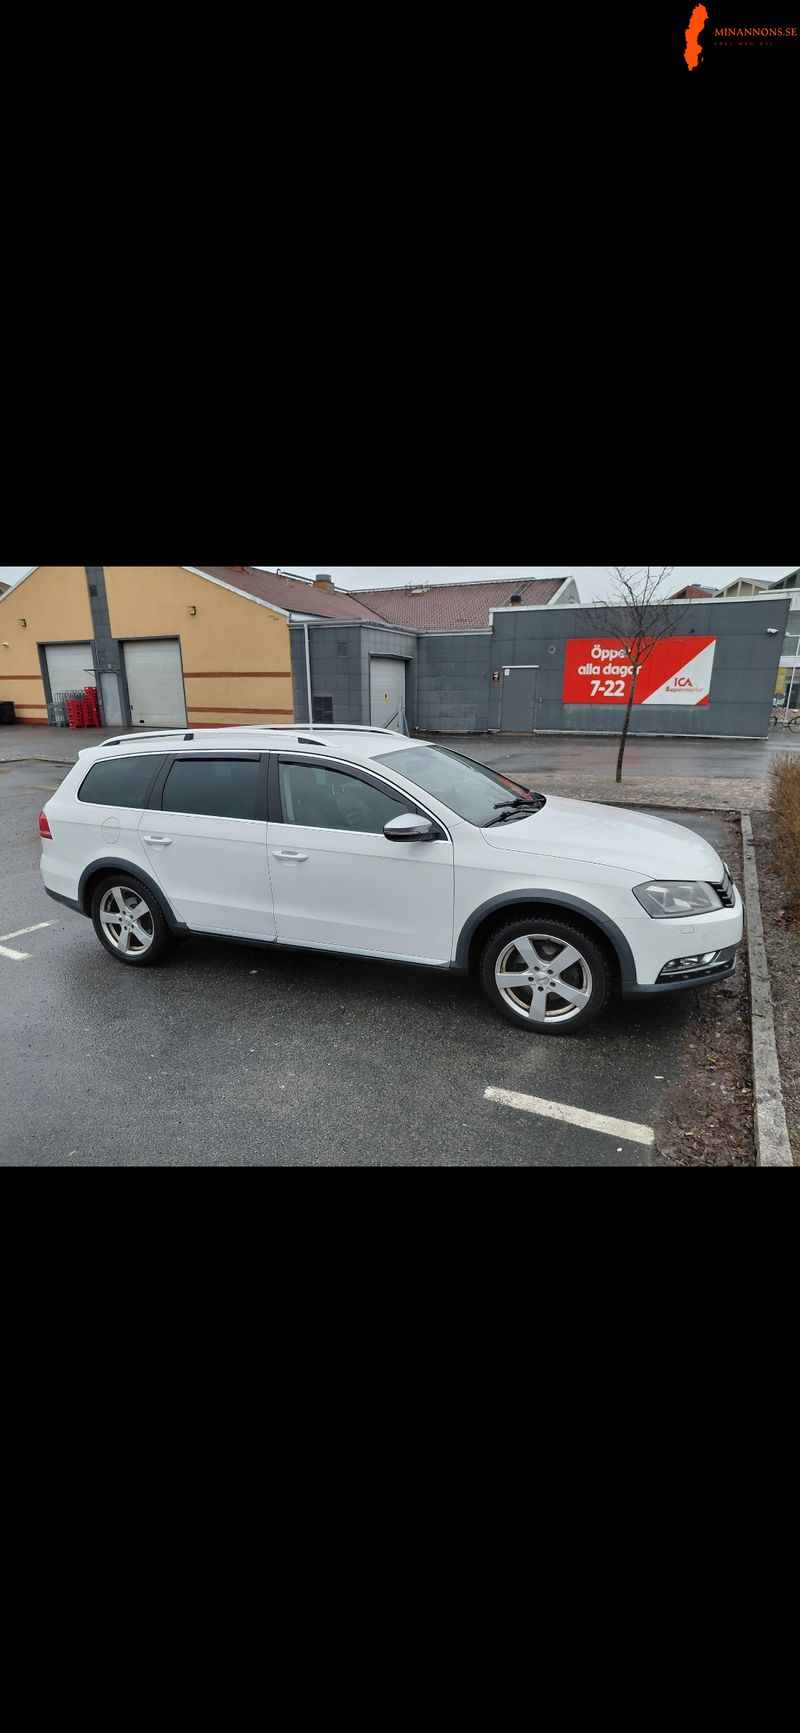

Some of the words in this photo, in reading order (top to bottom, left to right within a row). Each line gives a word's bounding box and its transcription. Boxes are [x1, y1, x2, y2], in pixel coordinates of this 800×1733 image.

[577, 663, 601, 675] alla
[674, 677, 693, 687] ICA
[590, 680, 626, 697] 7-22
